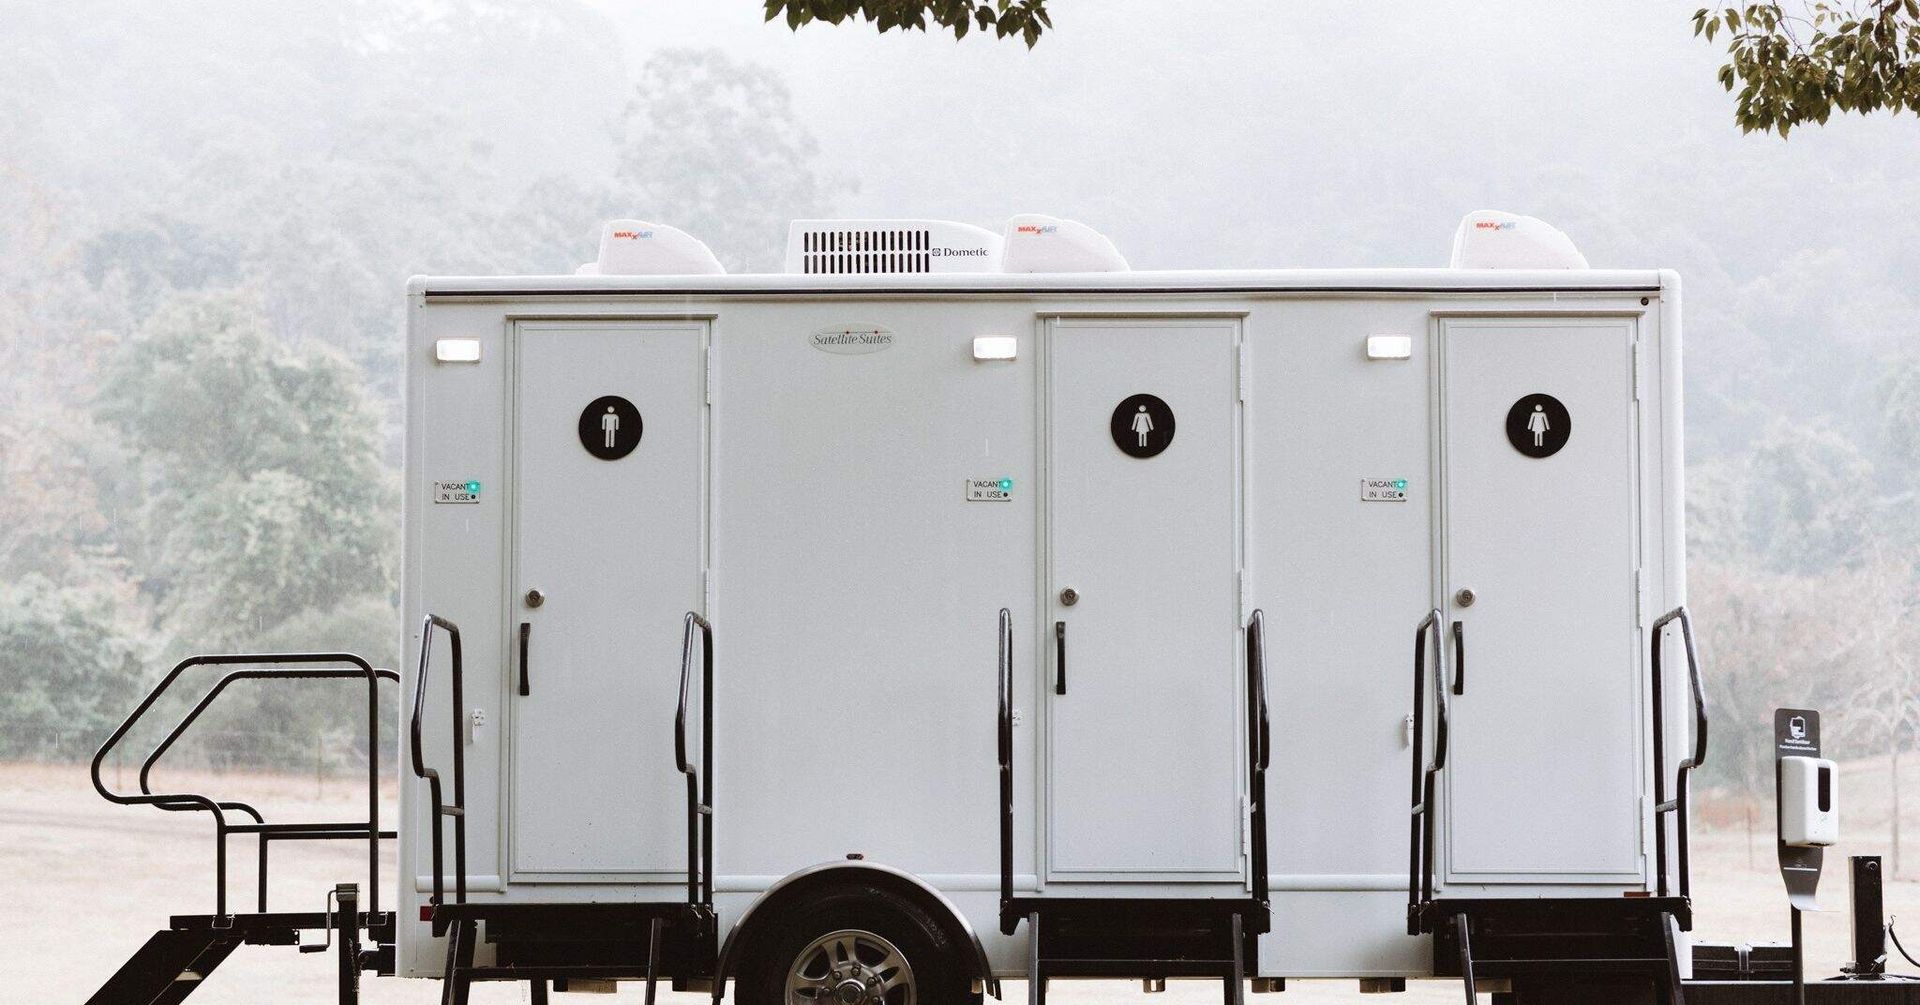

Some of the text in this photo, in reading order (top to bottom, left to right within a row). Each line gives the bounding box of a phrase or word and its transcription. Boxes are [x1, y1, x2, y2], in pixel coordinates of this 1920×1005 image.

[944, 247, 989, 257] Dometic
[814, 332, 892, 345] Satellite Suites
[441, 493, 470, 501] IN USE
[973, 490, 1002, 499] IN USE
[1369, 490, 1397, 499] IN USE
